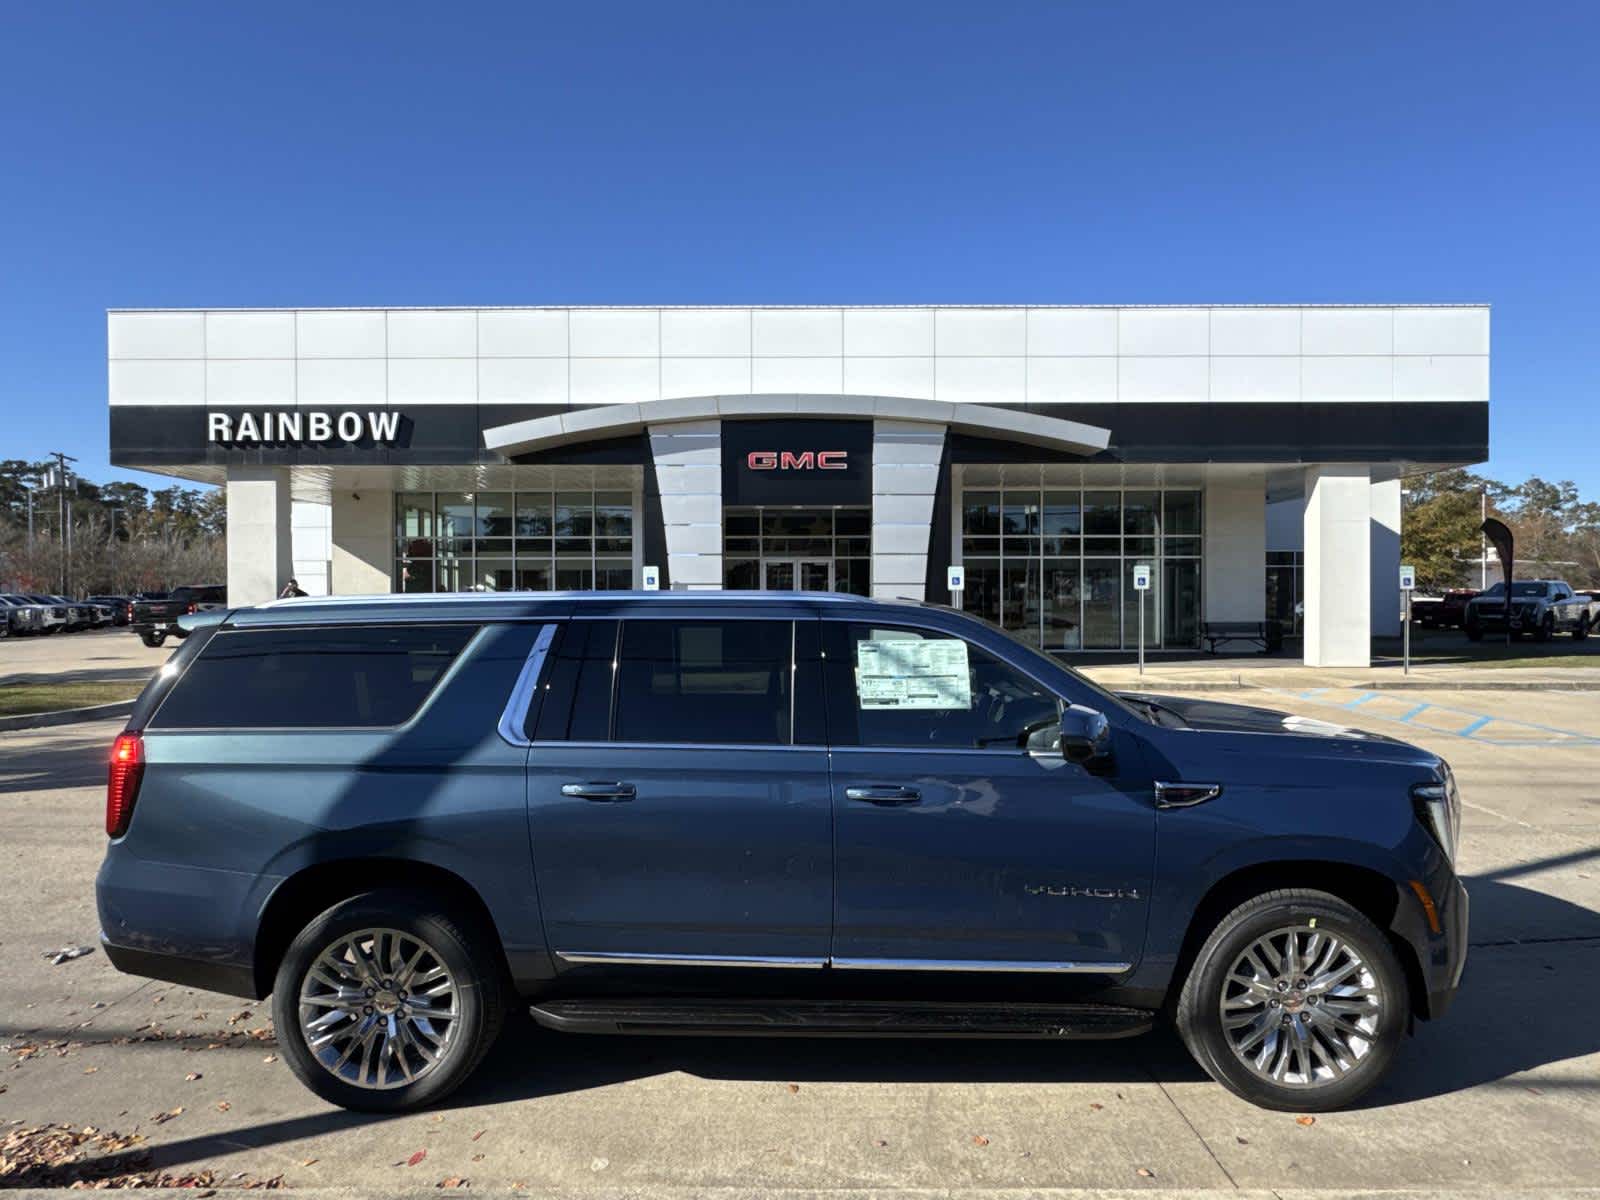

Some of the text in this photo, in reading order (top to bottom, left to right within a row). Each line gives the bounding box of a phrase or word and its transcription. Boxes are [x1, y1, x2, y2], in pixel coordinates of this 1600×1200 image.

[208, 411, 399, 442] RAINBOW
[747, 451, 848, 469] GMC
[1024, 883, 1140, 899] YUKON
